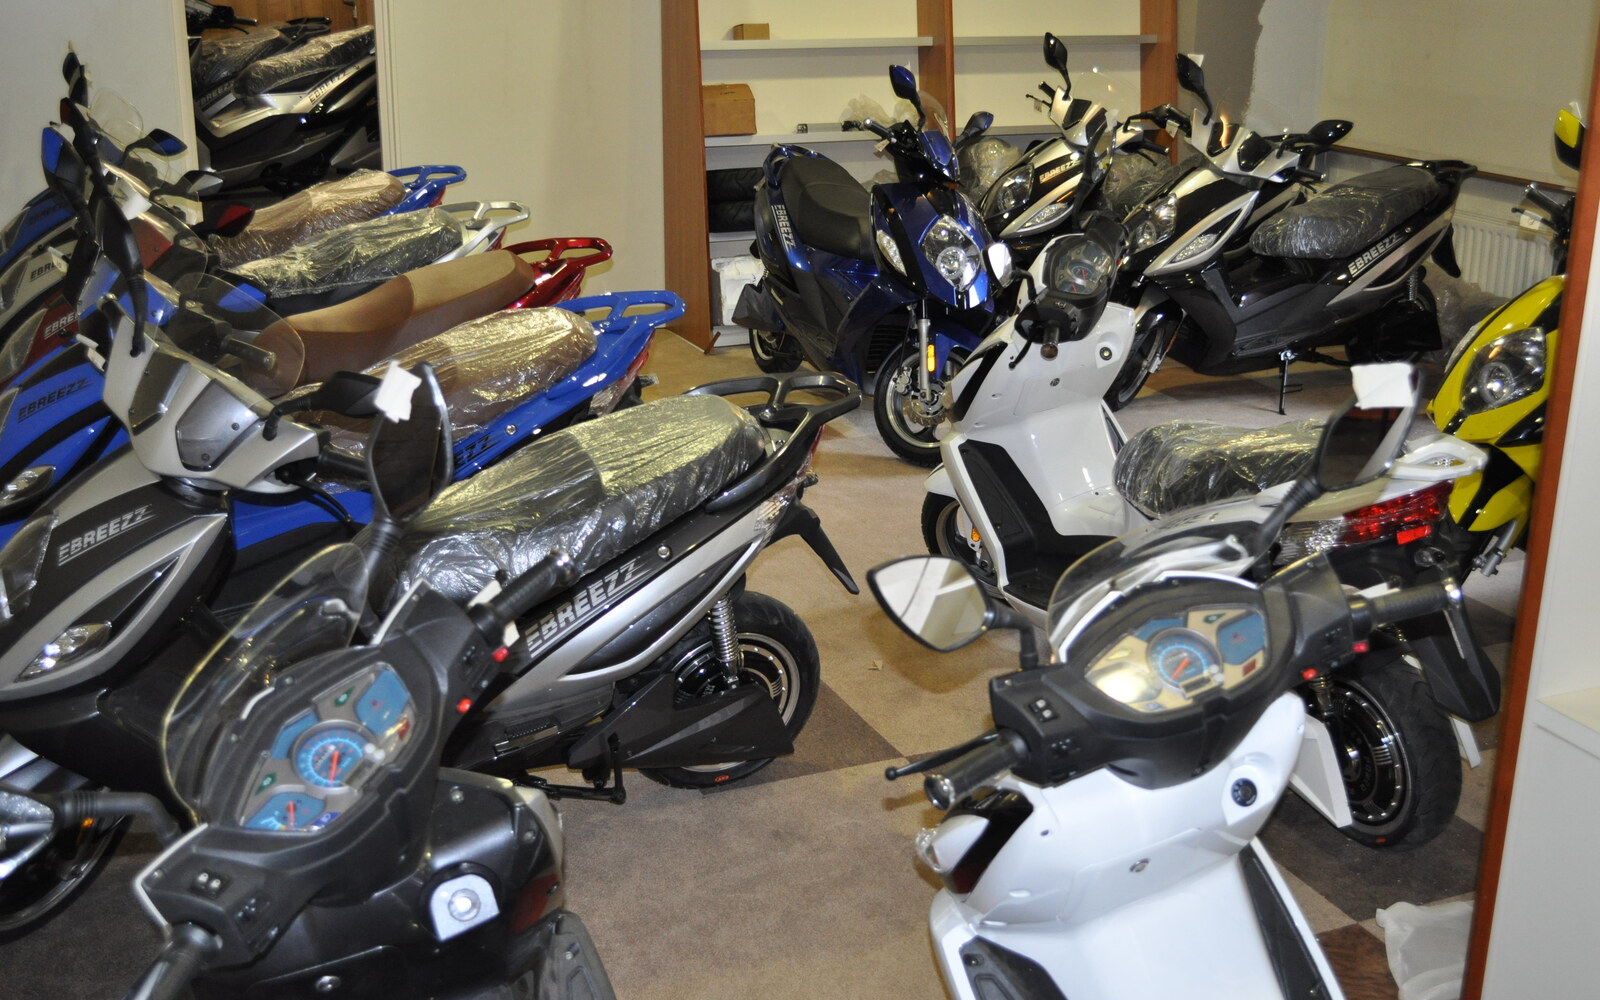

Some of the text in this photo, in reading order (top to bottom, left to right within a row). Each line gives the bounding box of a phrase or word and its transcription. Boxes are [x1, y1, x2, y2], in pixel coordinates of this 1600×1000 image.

[773, 204, 797, 248] EBREEZZ
[1348, 233, 1398, 275] EBREEZZ
[58, 503, 154, 563] EBREEZZ
[525, 556, 644, 653] EBREEZZ
